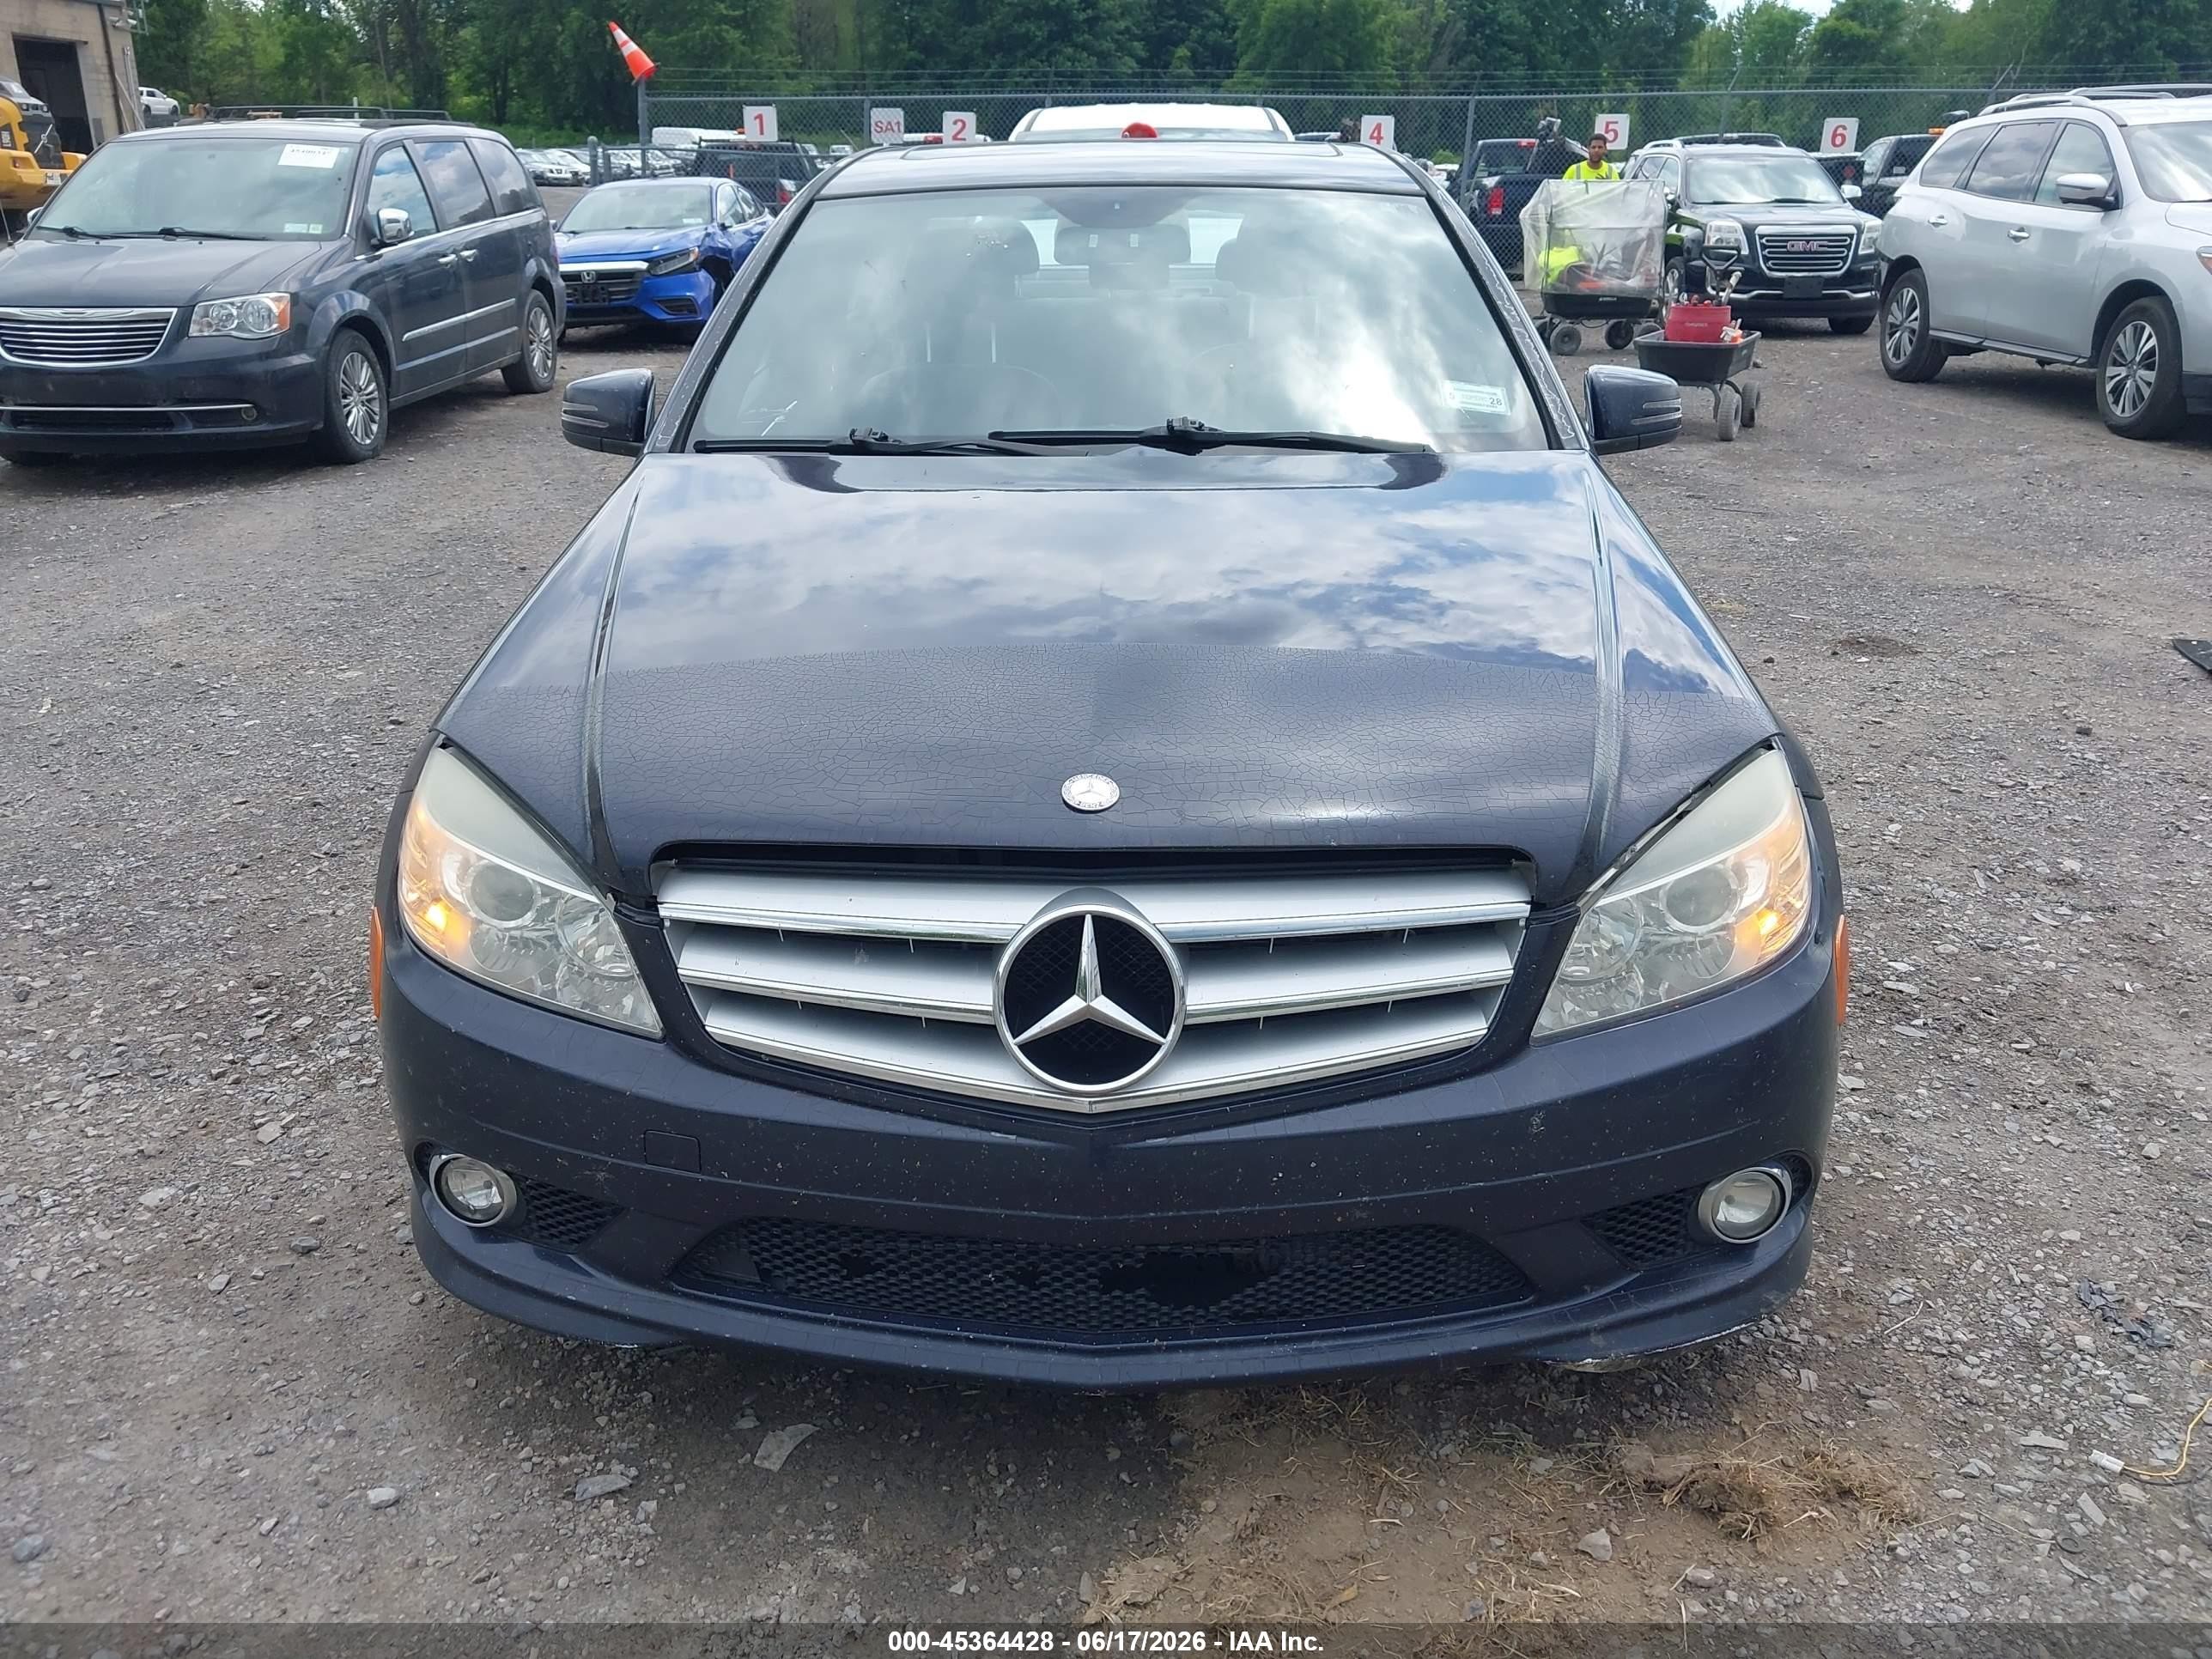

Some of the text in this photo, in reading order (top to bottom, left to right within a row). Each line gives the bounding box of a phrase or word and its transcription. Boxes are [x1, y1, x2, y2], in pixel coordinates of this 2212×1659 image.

[754, 113, 764, 136] 1
[874, 121, 902, 134] SA1
[951, 118, 967, 142] 2
[1369, 123, 1384, 144] 4
[1604, 121, 1619, 143] 5
[1831, 125, 1848, 148] 6
[1787, 240, 1828, 252] GMC
[1489, 397, 1503, 406] 28
